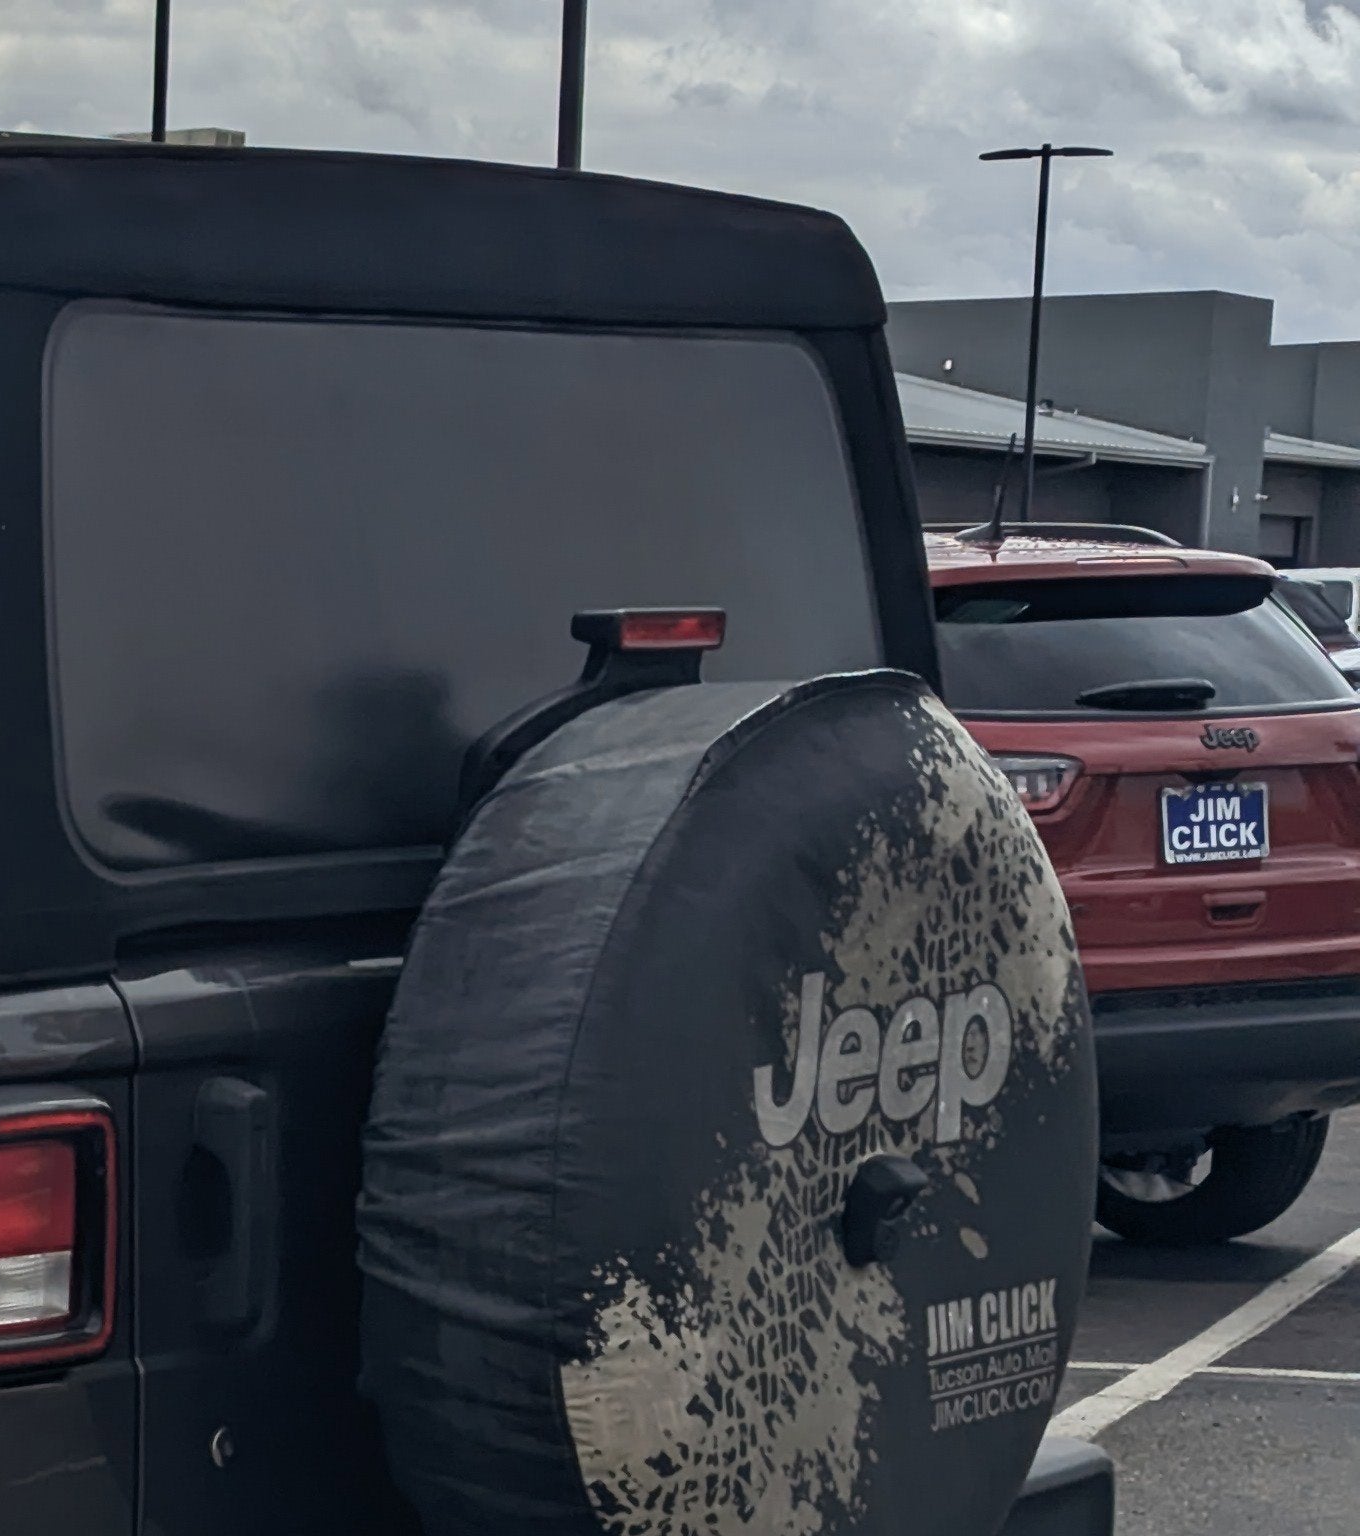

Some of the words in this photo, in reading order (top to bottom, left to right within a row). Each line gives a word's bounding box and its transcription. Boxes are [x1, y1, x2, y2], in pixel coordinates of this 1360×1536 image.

[1200, 723, 1260, 752] Jeep
[1189, 797, 1241, 823] JIM
[1171, 822, 1258, 850] CLICK
[753, 971, 1013, 1147] Jeep
[927, 1297, 974, 1357] JIM
[980, 1278, 1057, 1345] CLICK
[929, 1364, 984, 1392] Tucson
